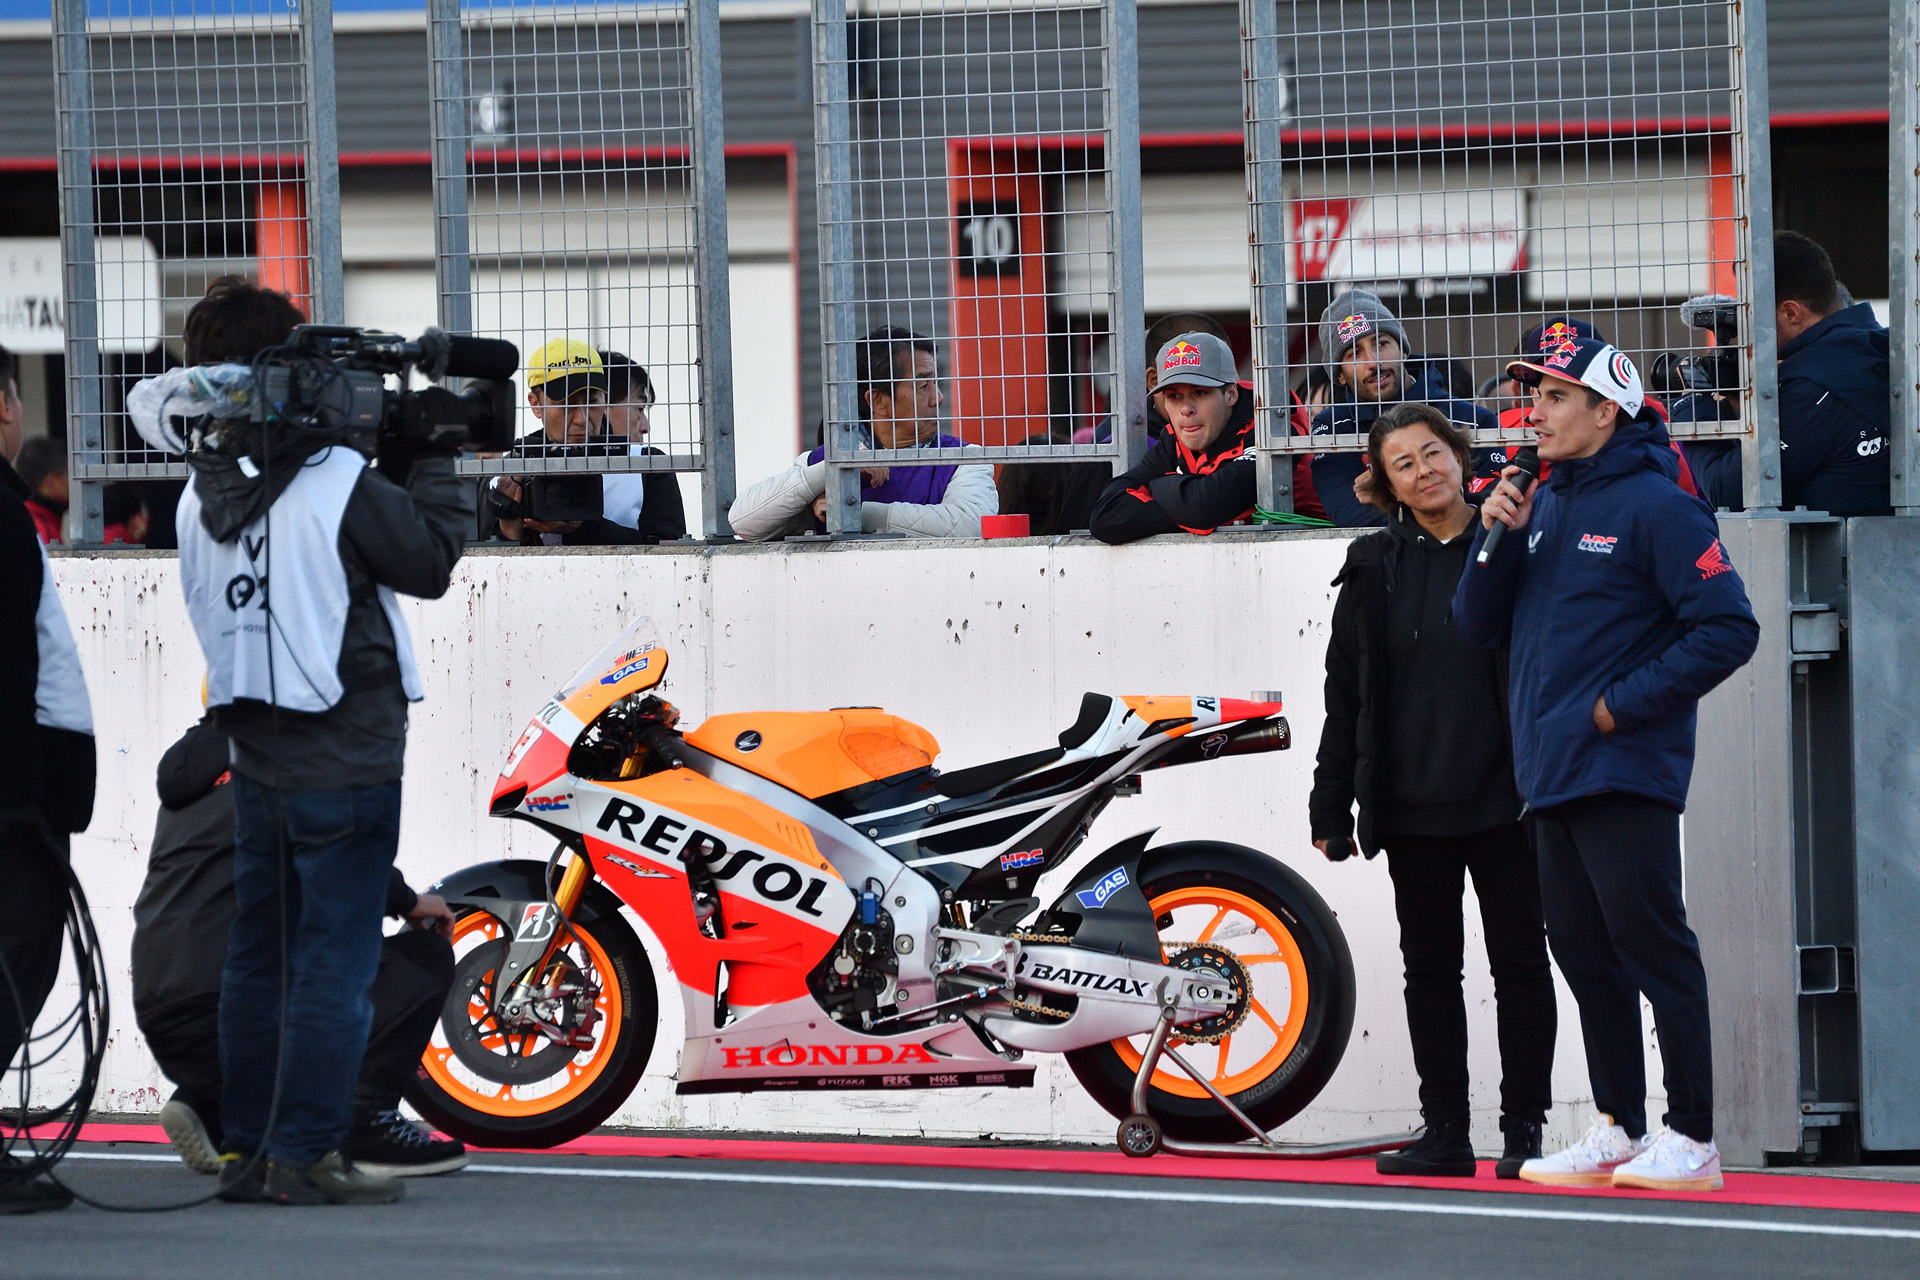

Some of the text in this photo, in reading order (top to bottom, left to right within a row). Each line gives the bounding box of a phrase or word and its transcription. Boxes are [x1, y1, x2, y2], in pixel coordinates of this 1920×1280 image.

[963, 216, 1014, 264] 10
[1354, 321, 1371, 335] Bull
[1164, 355, 1200, 370] Red Bull
[1701, 564, 1734, 580] HOND
[635, 640, 656, 657] 93
[612, 659, 648, 682] GAS
[525, 795, 570, 813] HRC
[596, 797, 827, 917] REPSOL
[1000, 848, 1045, 871] HRC
[1094, 871, 1126, 902] GAS
[612, 956, 632, 1019] BRIDGESTONE
[1030, 963, 1150, 998] BATTLAX
[720, 1043, 939, 1068] HONDA
[827, 1078, 866, 1087] YUTAKA
[882, 1075, 912, 1085] RK
[929, 1074, 959, 1084] NGK
